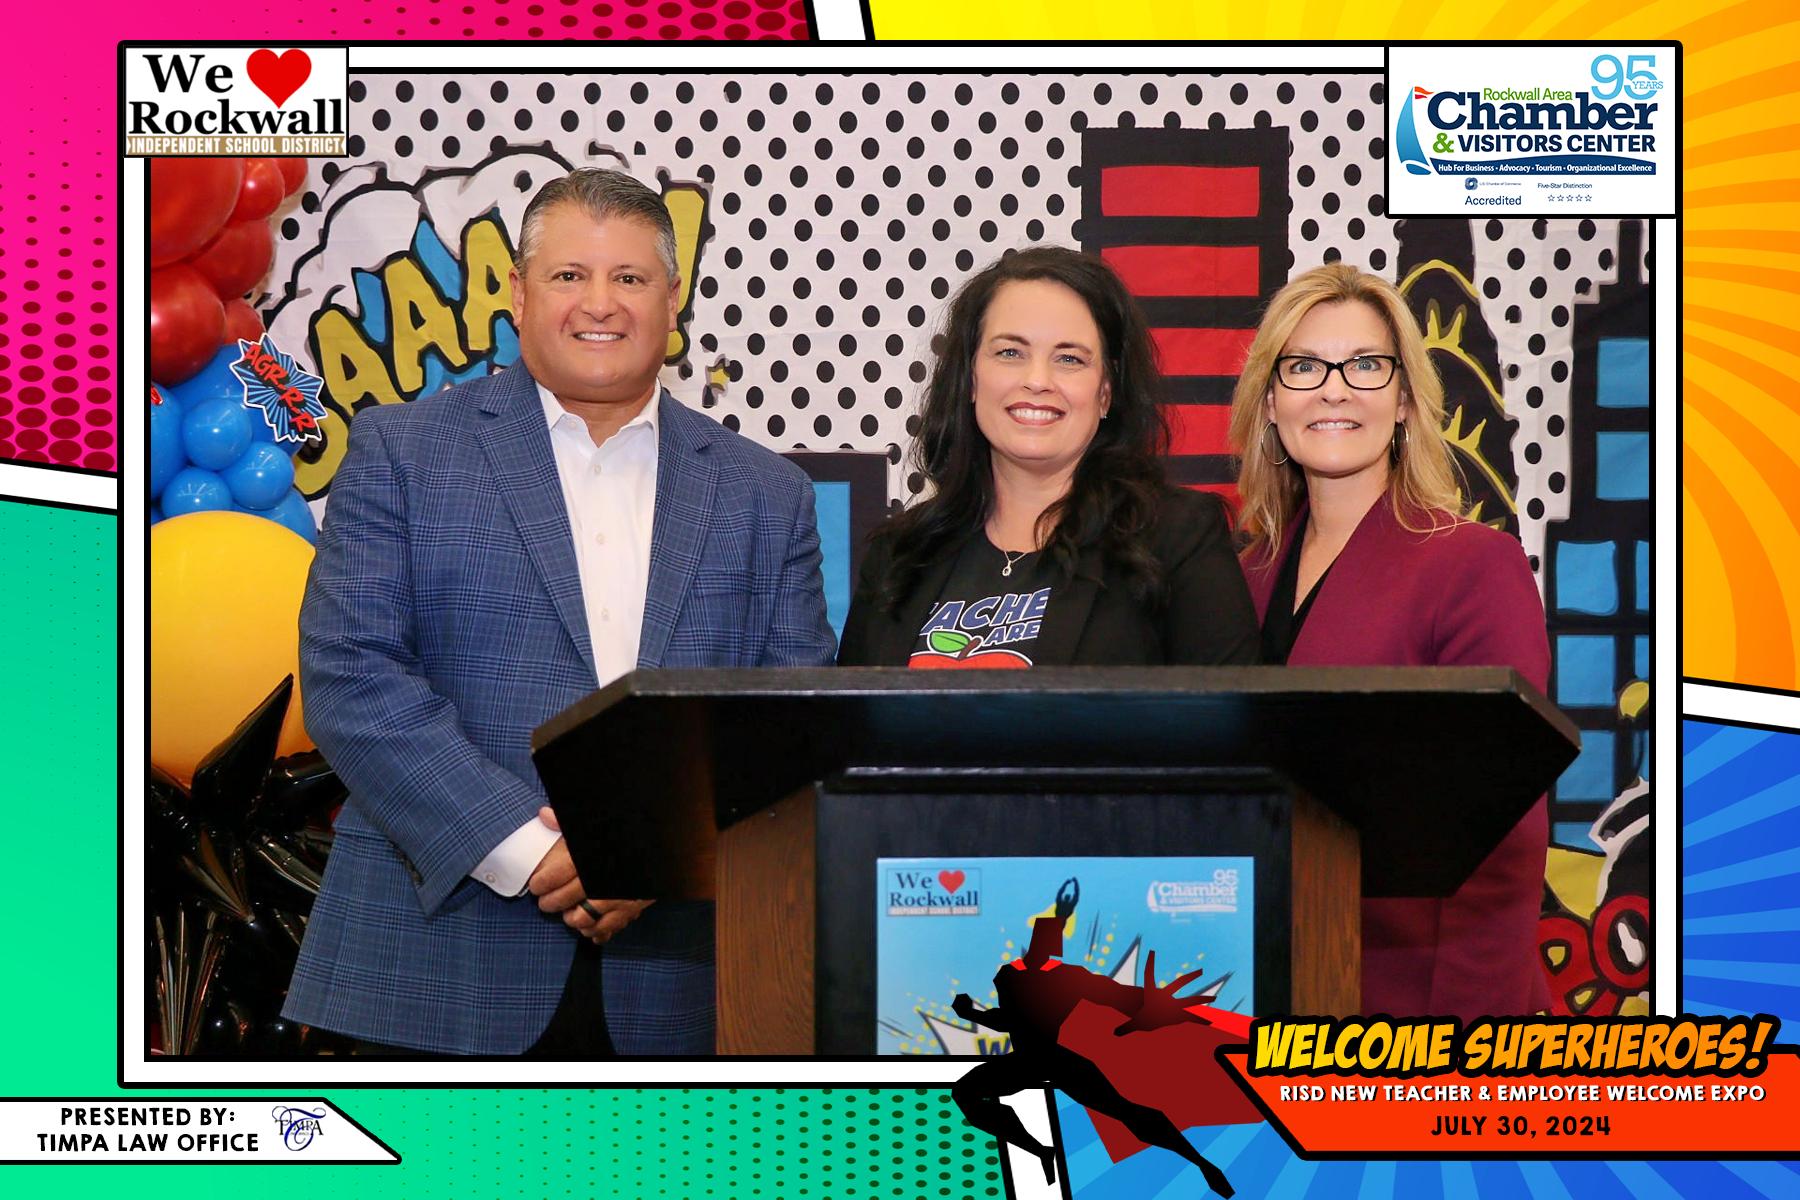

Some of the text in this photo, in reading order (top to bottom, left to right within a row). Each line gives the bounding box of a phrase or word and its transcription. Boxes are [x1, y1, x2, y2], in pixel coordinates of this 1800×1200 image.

[920, 588, 1051, 635] ACHE
[982, 620, 1042, 646] ARE
[896, 872, 933, 889] We
[889, 891, 978, 907] Rockwall
